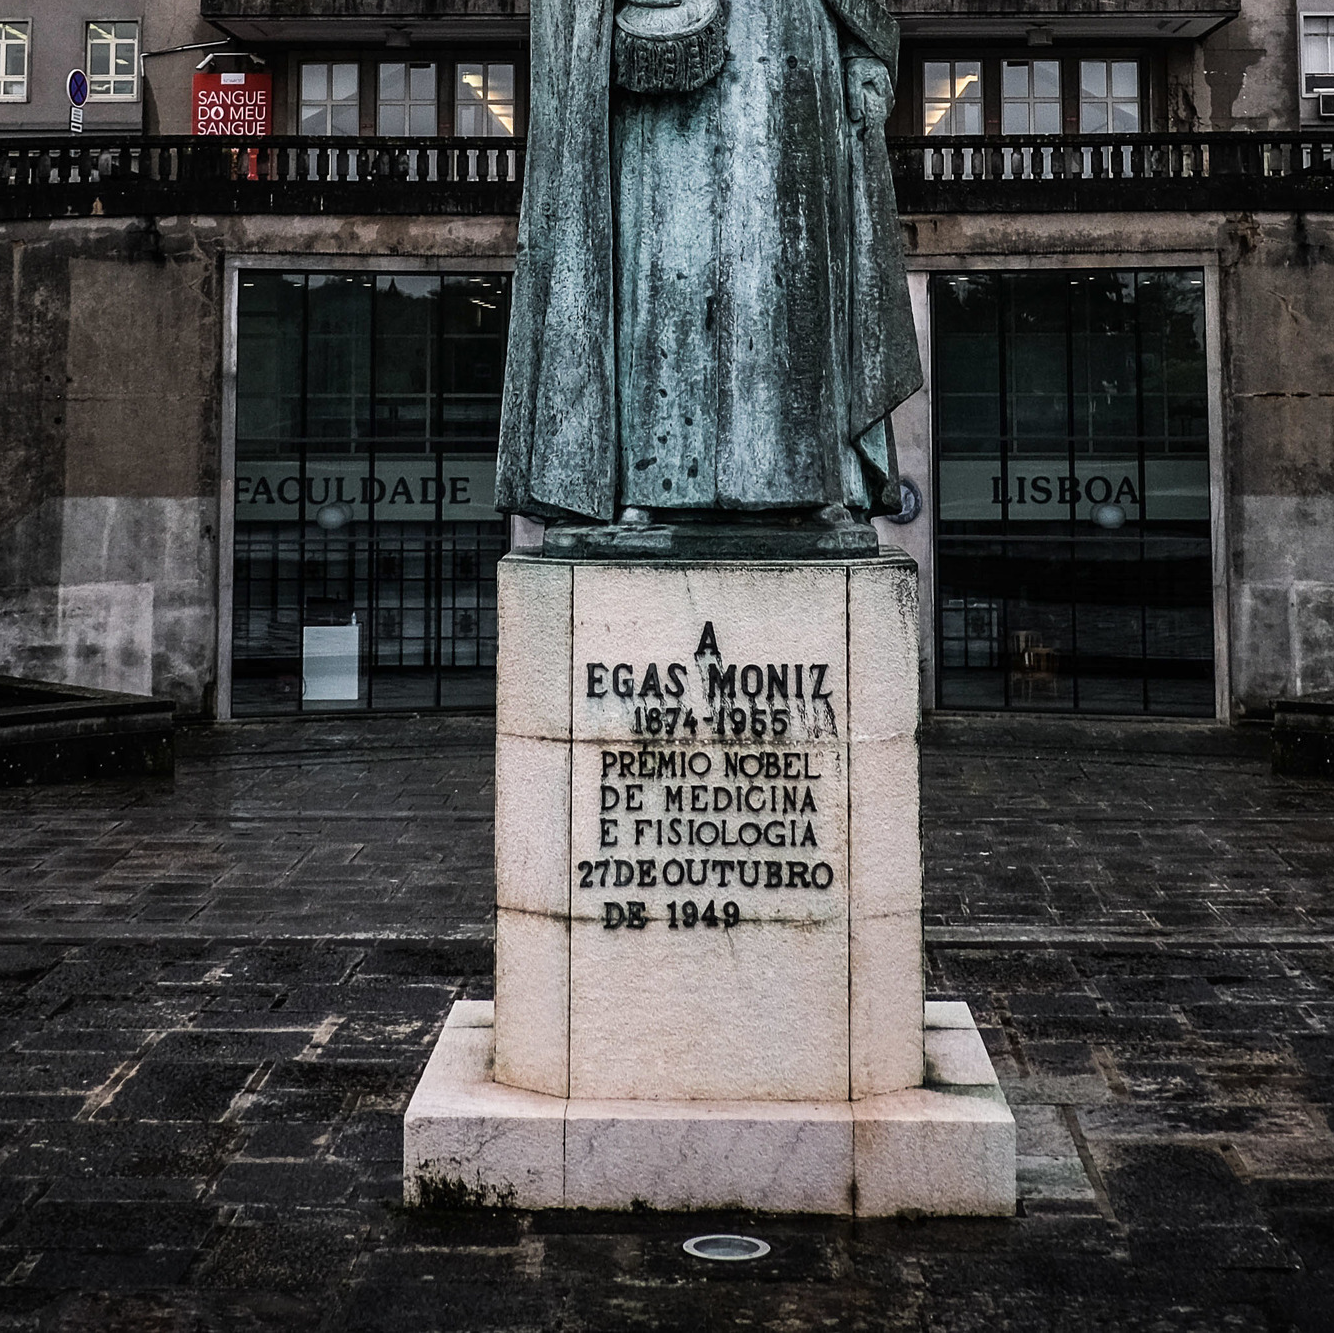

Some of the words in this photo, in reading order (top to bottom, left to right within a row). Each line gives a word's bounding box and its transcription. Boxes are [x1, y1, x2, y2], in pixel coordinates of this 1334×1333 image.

[198, 90, 267, 105] SANGUE
[198, 106, 225, 121] DO
[229, 106, 267, 121] MEU
[197, 121, 267, 136] SANGUE
[234, 475, 472, 506] FACULDADE
[991, 475, 1140, 505] LISBOA
[694, 620, 721, 657] A
[586, 662, 688, 699] EGAS
[708, 662, 833, 700] MONIZ
[634, 707, 789, 736] 1874-1955
[724, 751, 822, 779] NOBEL
[601, 785, 644, 813] DE
[665, 785, 818, 814] MEDICINA
[600, 818, 619, 847] E
[634, 818, 818, 847] FISIOLOGIA
[603, 902, 648, 930] DE
[667, 900, 740, 930] 1949
